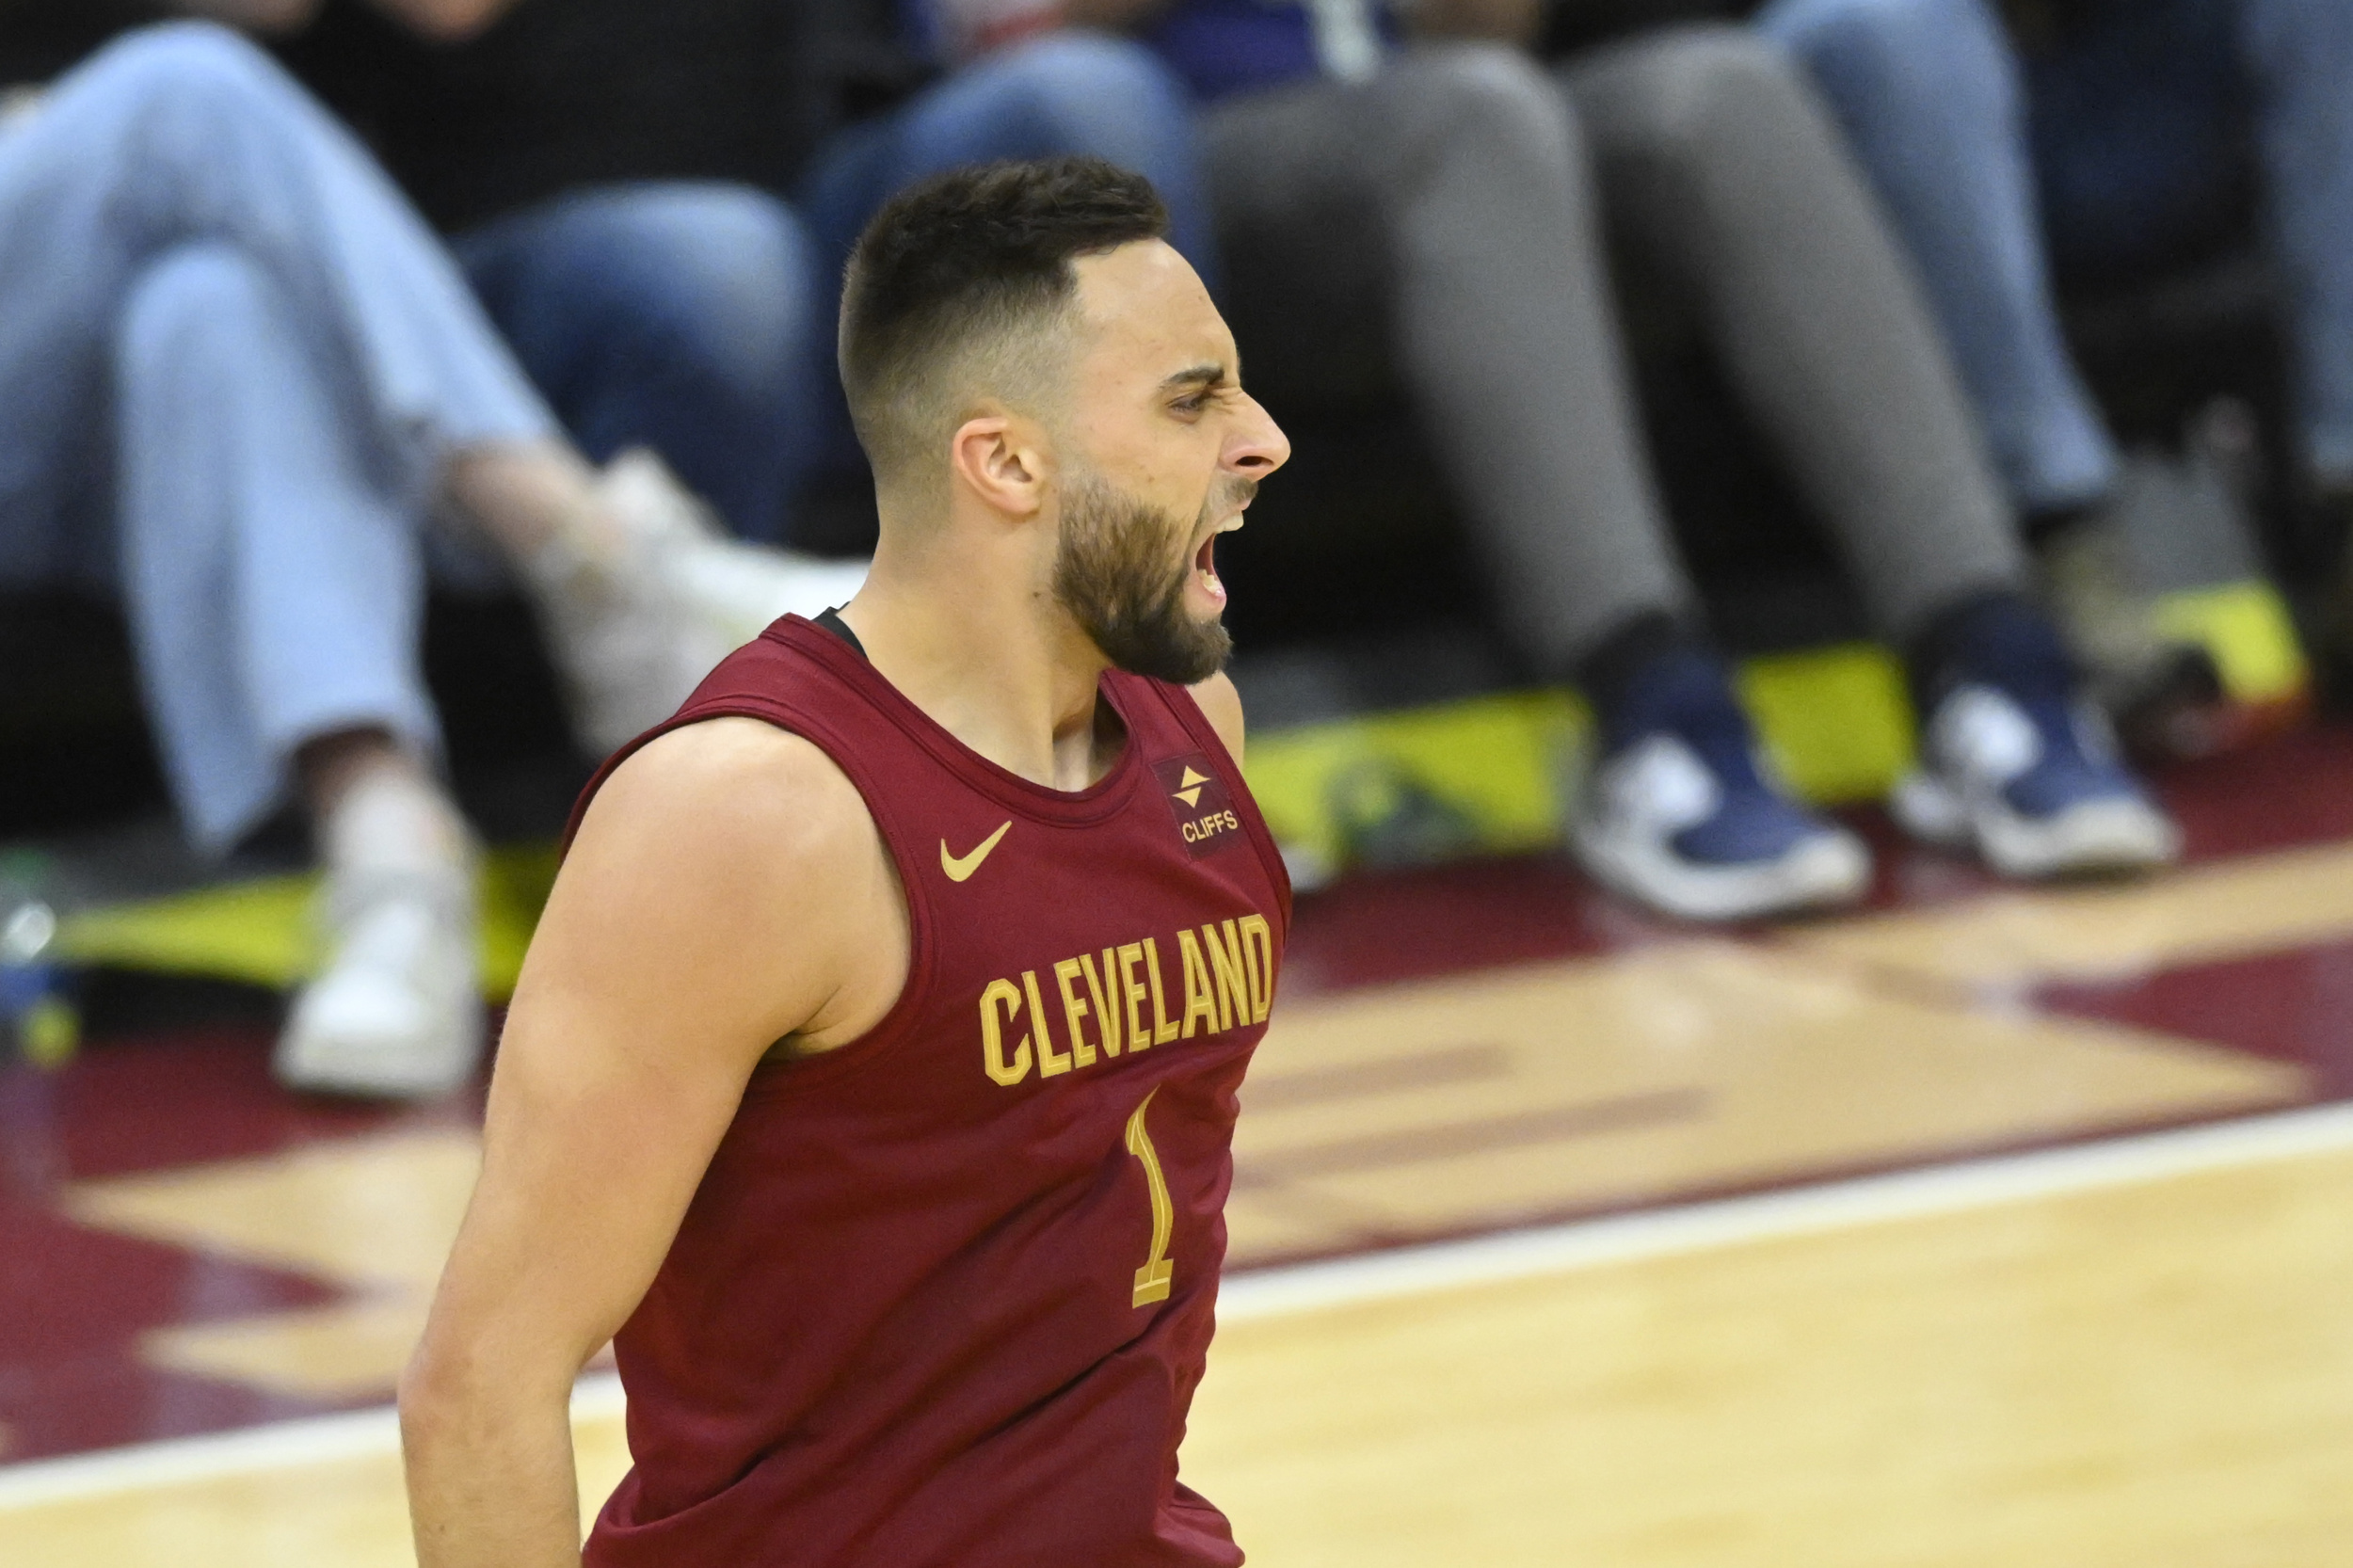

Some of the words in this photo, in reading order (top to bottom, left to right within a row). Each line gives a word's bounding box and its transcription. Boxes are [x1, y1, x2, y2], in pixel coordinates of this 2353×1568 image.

[1182, 810, 1238, 843] CLIFFS
[979, 914, 1273, 1086] CLEVELAND
[1124, 1083, 1175, 1309] 1
